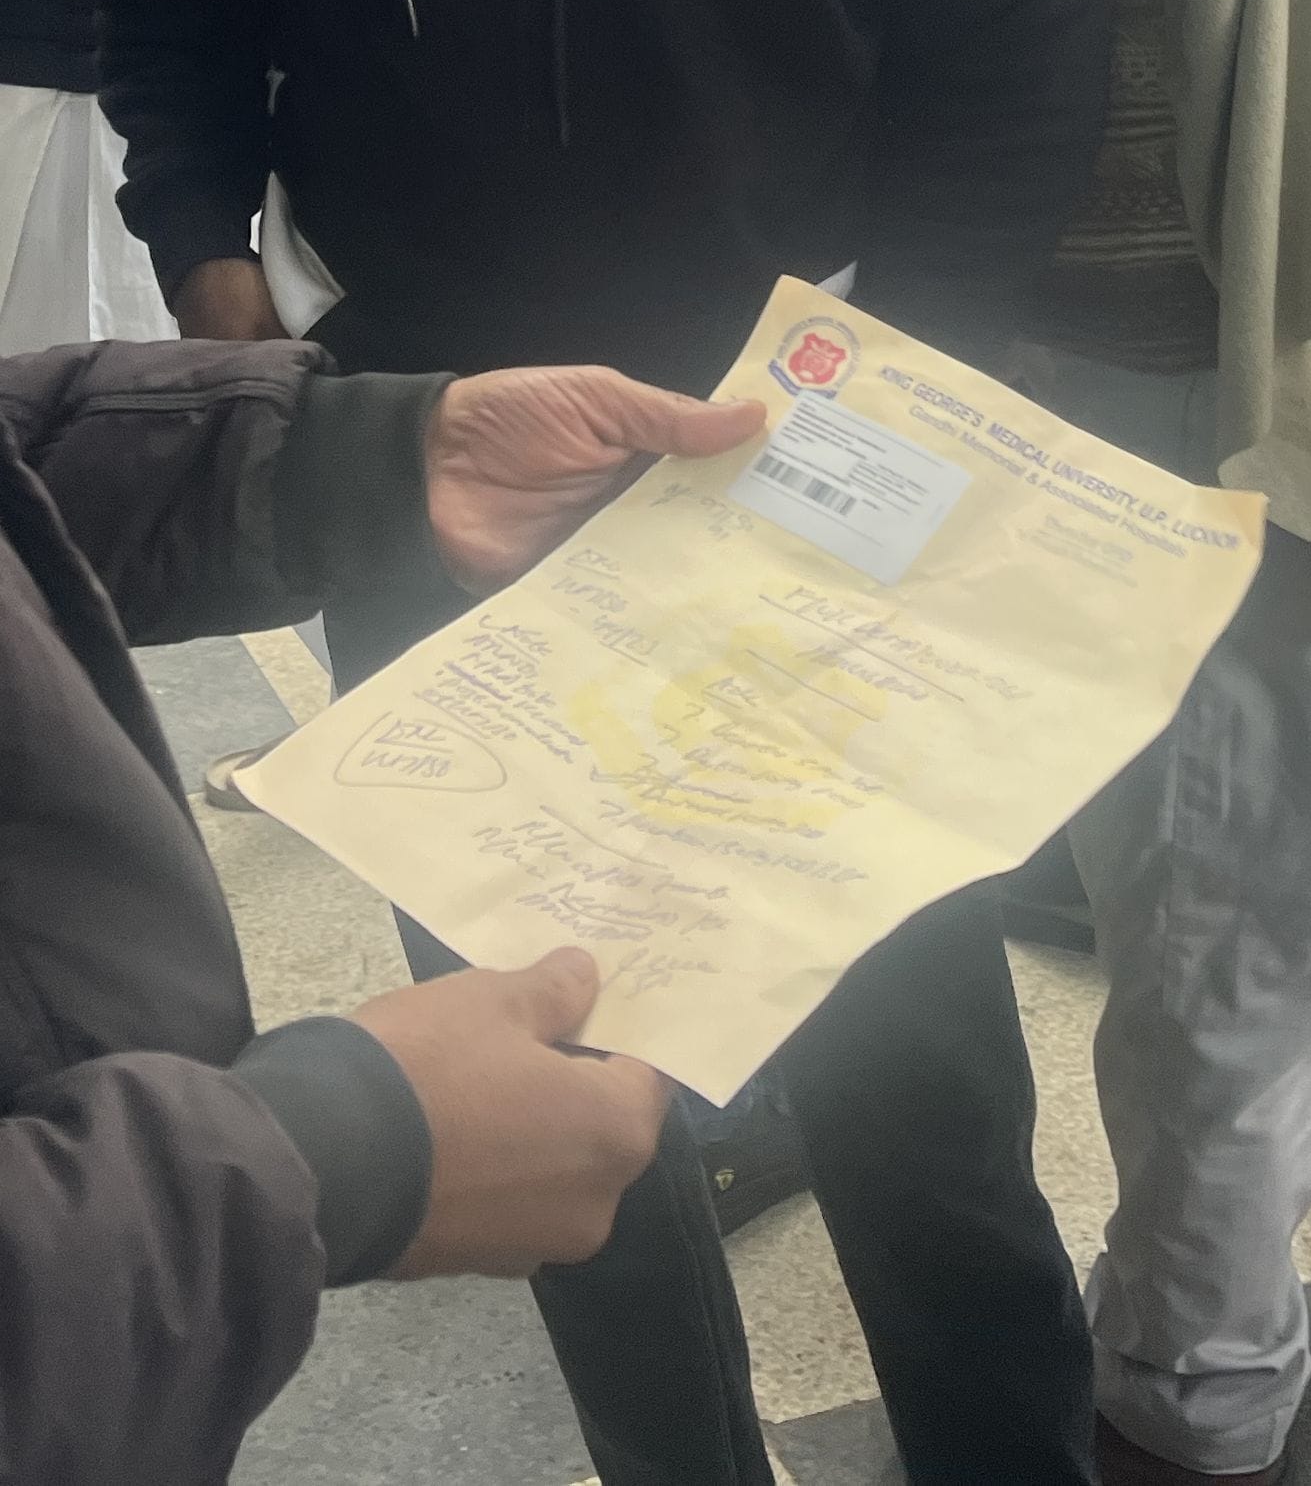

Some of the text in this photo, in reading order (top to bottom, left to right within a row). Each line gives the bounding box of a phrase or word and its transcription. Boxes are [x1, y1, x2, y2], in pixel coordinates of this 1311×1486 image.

[909, 405, 957, 438] Gandhi
[960, 430, 1027, 477] Memorial
[1026, 471, 1038, 485] &
[1039, 479, 1118, 525] Associated
[1119, 514, 1188, 559] Hospitals
[913, 383, 985, 427] GEORGE'S
[987, 421, 1048, 469] MEDICAL
